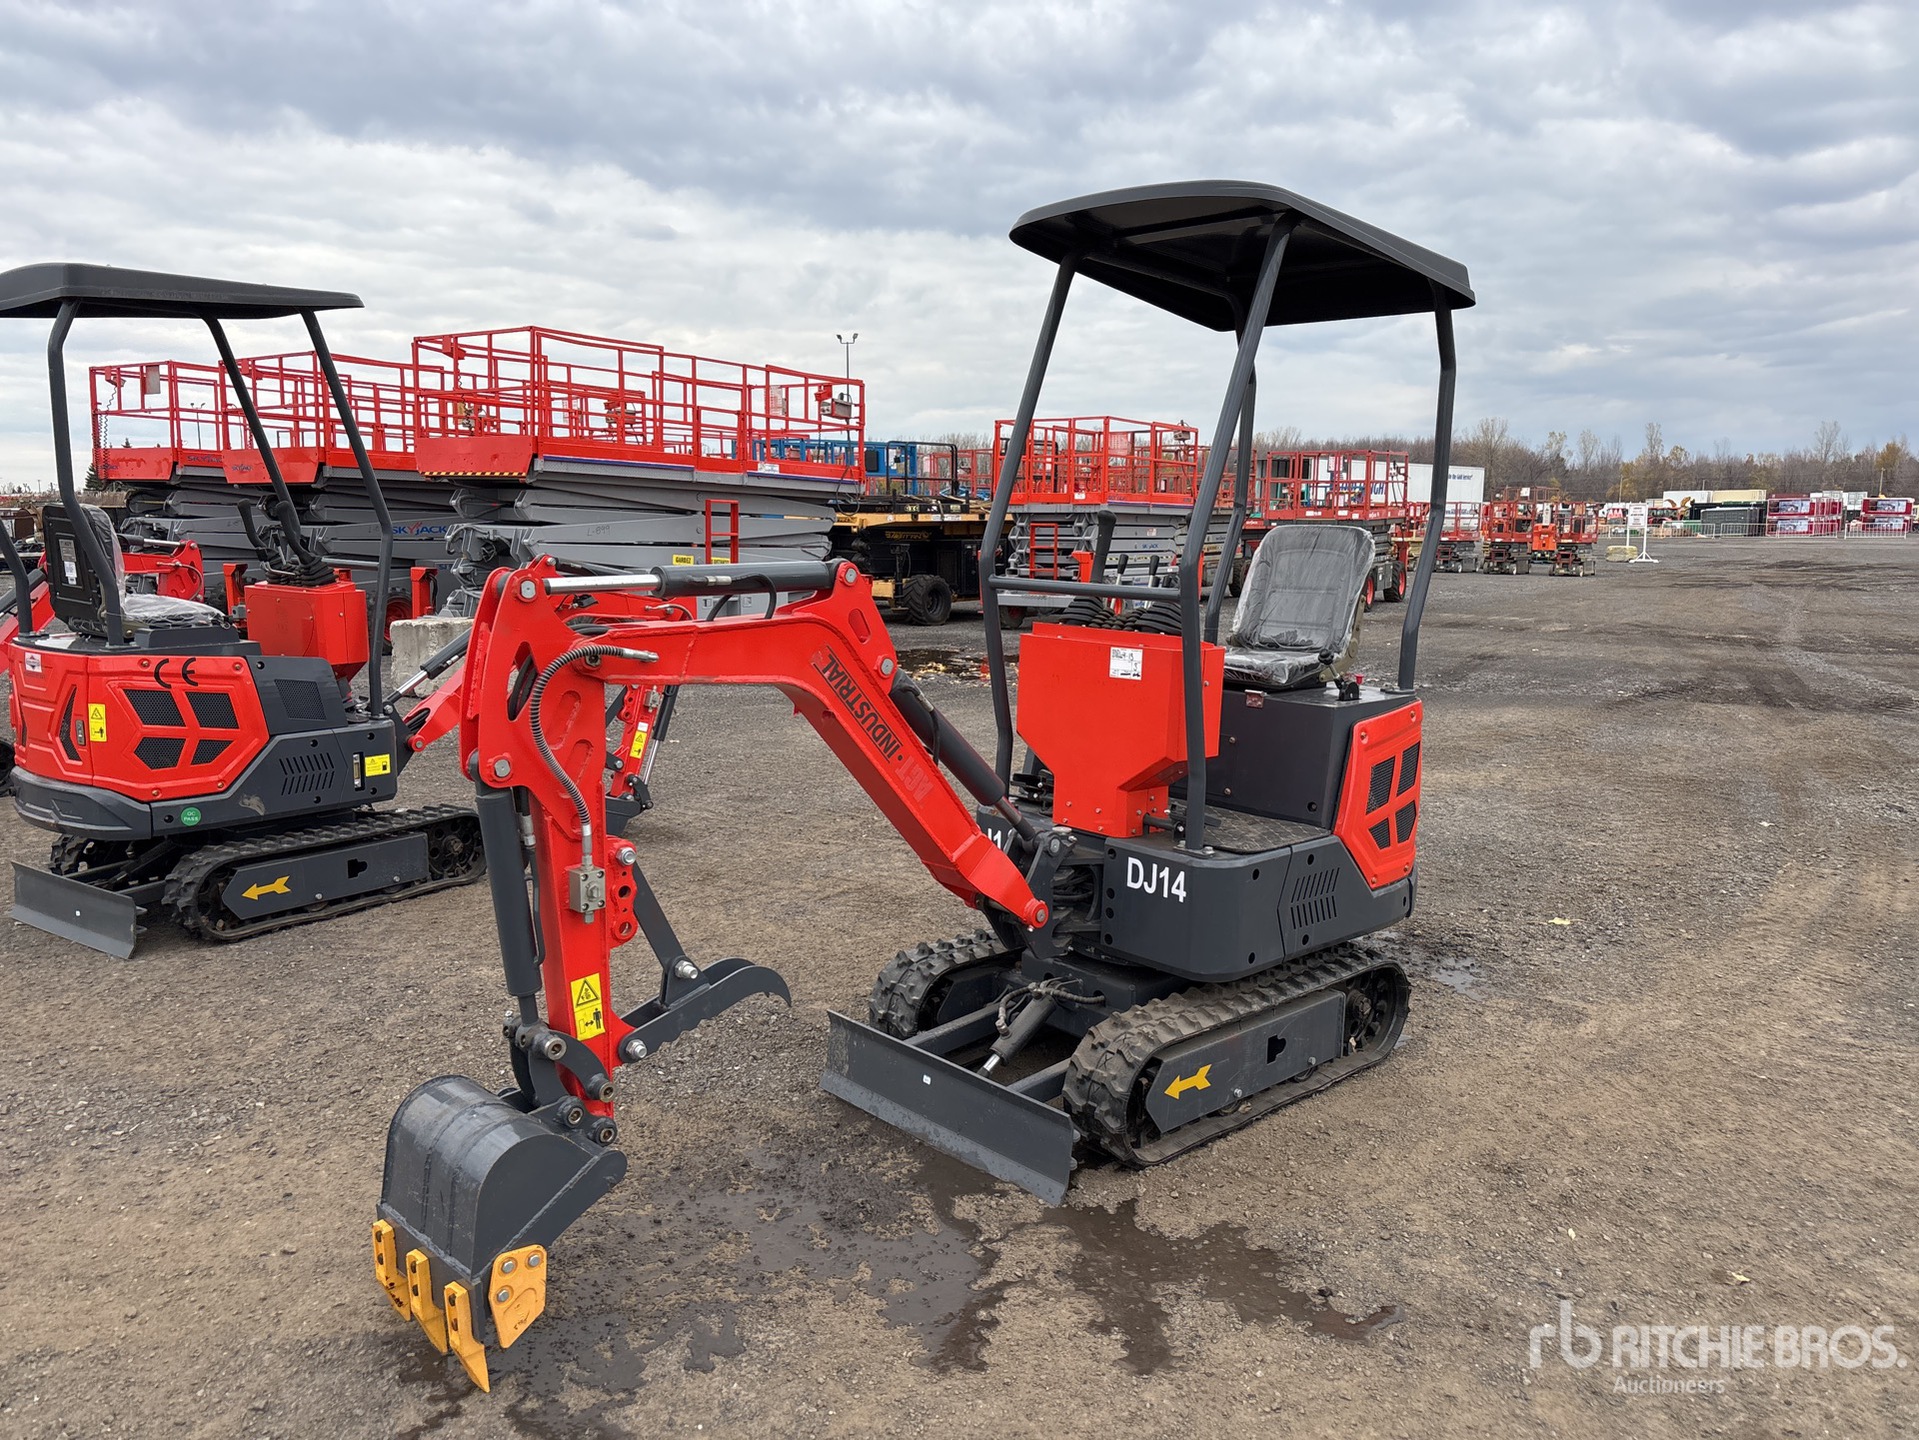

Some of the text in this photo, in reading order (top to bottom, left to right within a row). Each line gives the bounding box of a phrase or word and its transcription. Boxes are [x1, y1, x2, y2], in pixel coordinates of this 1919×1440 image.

[393, 521, 447, 535] SKYJACK
[821, 653, 901, 760] INDUSTRIAL
[1126, 856, 1188, 903] DJ14
